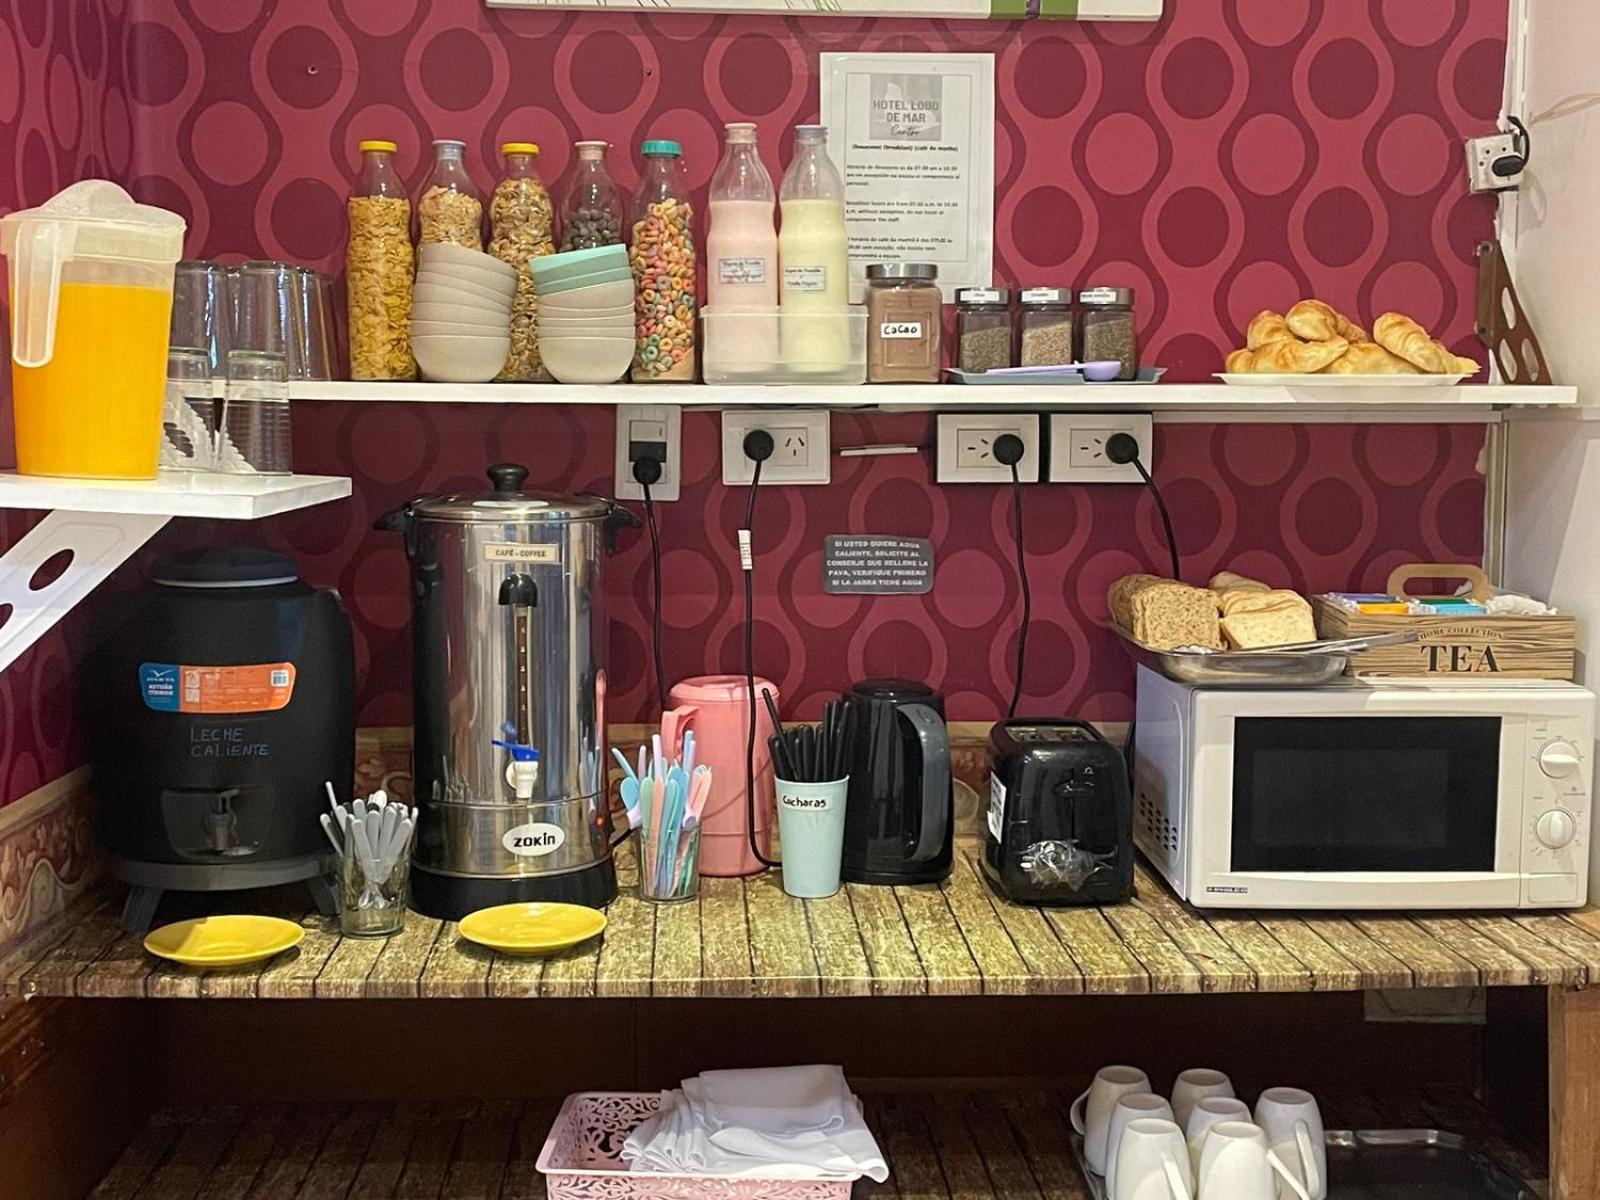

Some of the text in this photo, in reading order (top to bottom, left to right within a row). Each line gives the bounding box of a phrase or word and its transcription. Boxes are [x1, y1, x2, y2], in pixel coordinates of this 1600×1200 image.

[873, 100, 940, 111] HOTEL LOBO
[886, 112, 926, 123] DE MAR
[496, 548, 514, 556] CAFÉ
[1420, 628, 1504, 640] HOME COLLECTION
[1420, 645, 1501, 672] TEA
[190, 727, 244, 742] LECHE
